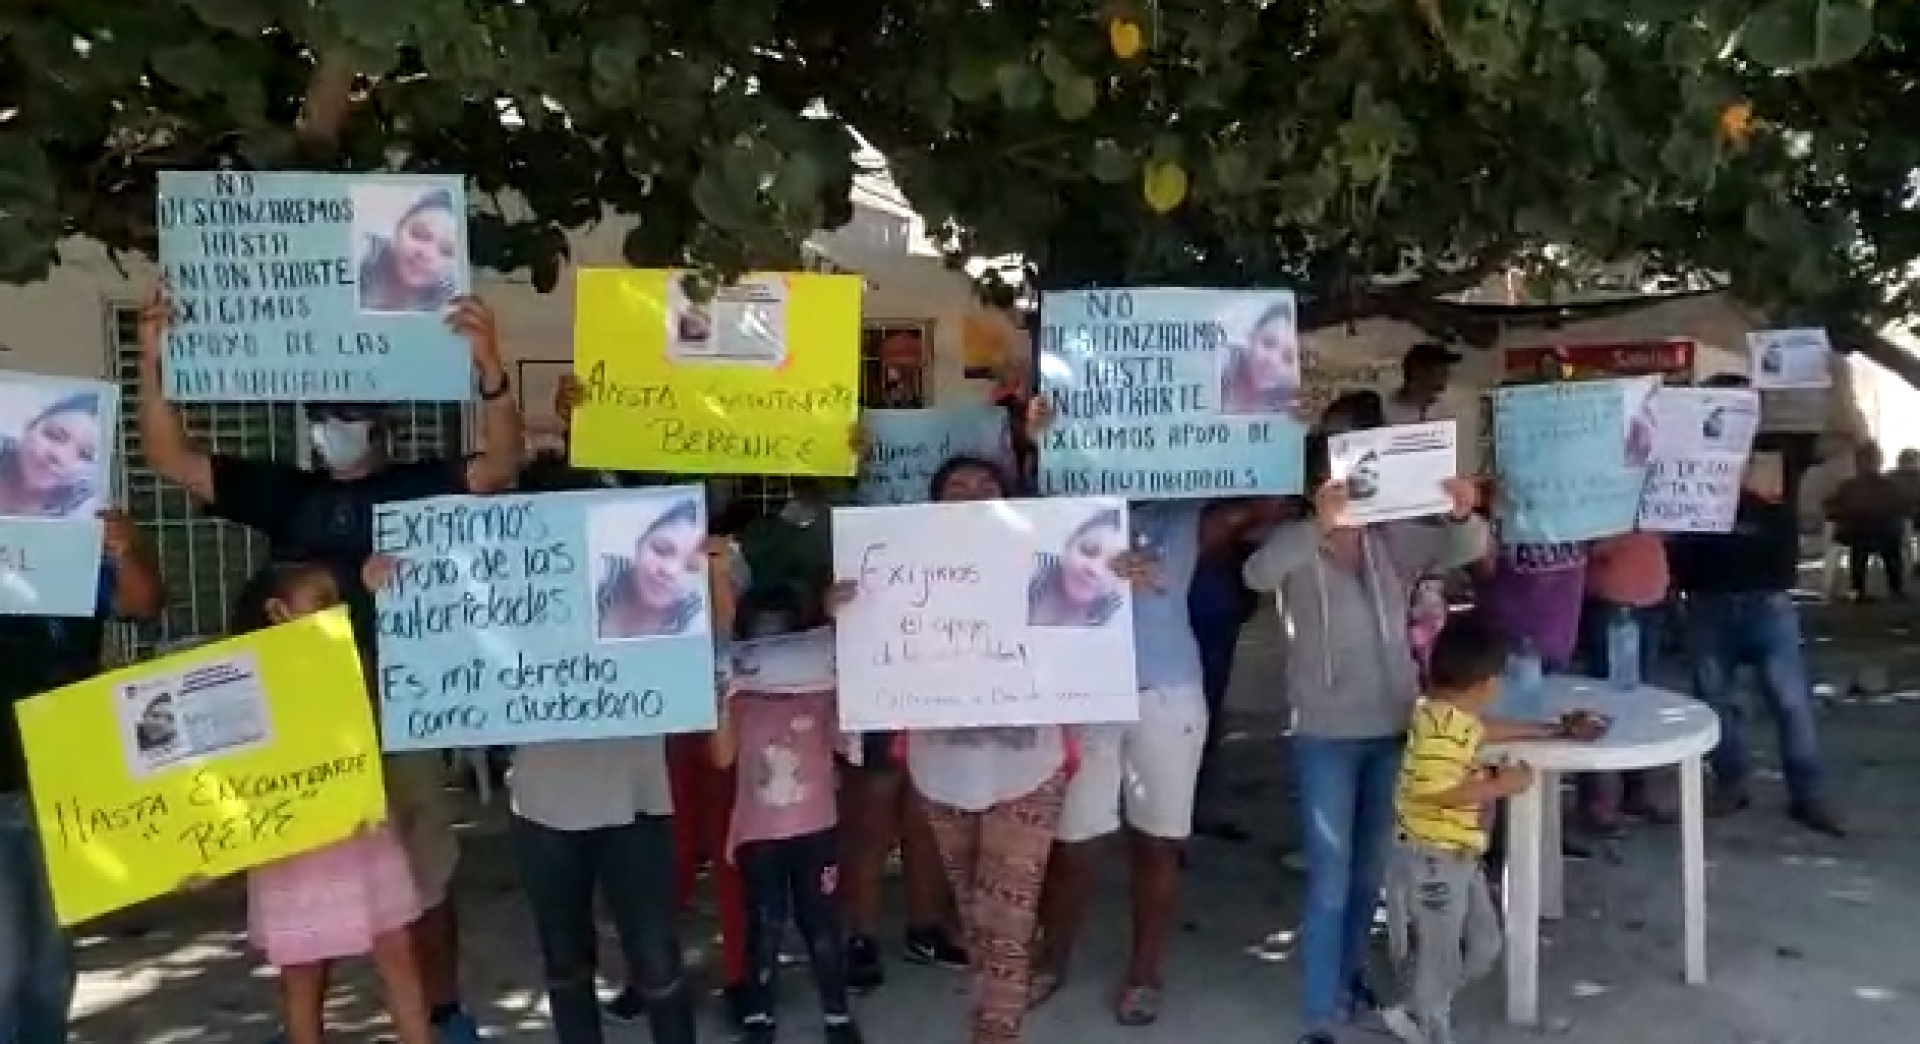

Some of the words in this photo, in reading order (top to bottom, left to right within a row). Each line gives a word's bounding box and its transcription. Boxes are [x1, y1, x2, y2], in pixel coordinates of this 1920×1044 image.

[215, 173, 255, 196] NO
[201, 231, 289, 258] HASTA
[1086, 292, 1134, 319] NO
[285, 331, 320, 357] DE
[337, 332, 391, 356] LAS
[1085, 355, 1174, 388] HASTA
[1051, 384, 1210, 418] NCONTRARTE
[468, 545, 512, 583] de
[523, 541, 576, 579] las
[382, 664, 429, 701] Es
[440, 656, 487, 696] mi
[498, 651, 619, 692] derecho
[407, 703, 489, 740] como
[505, 686, 665, 725] ciudadano
[55, 793, 170, 850] HASTA
